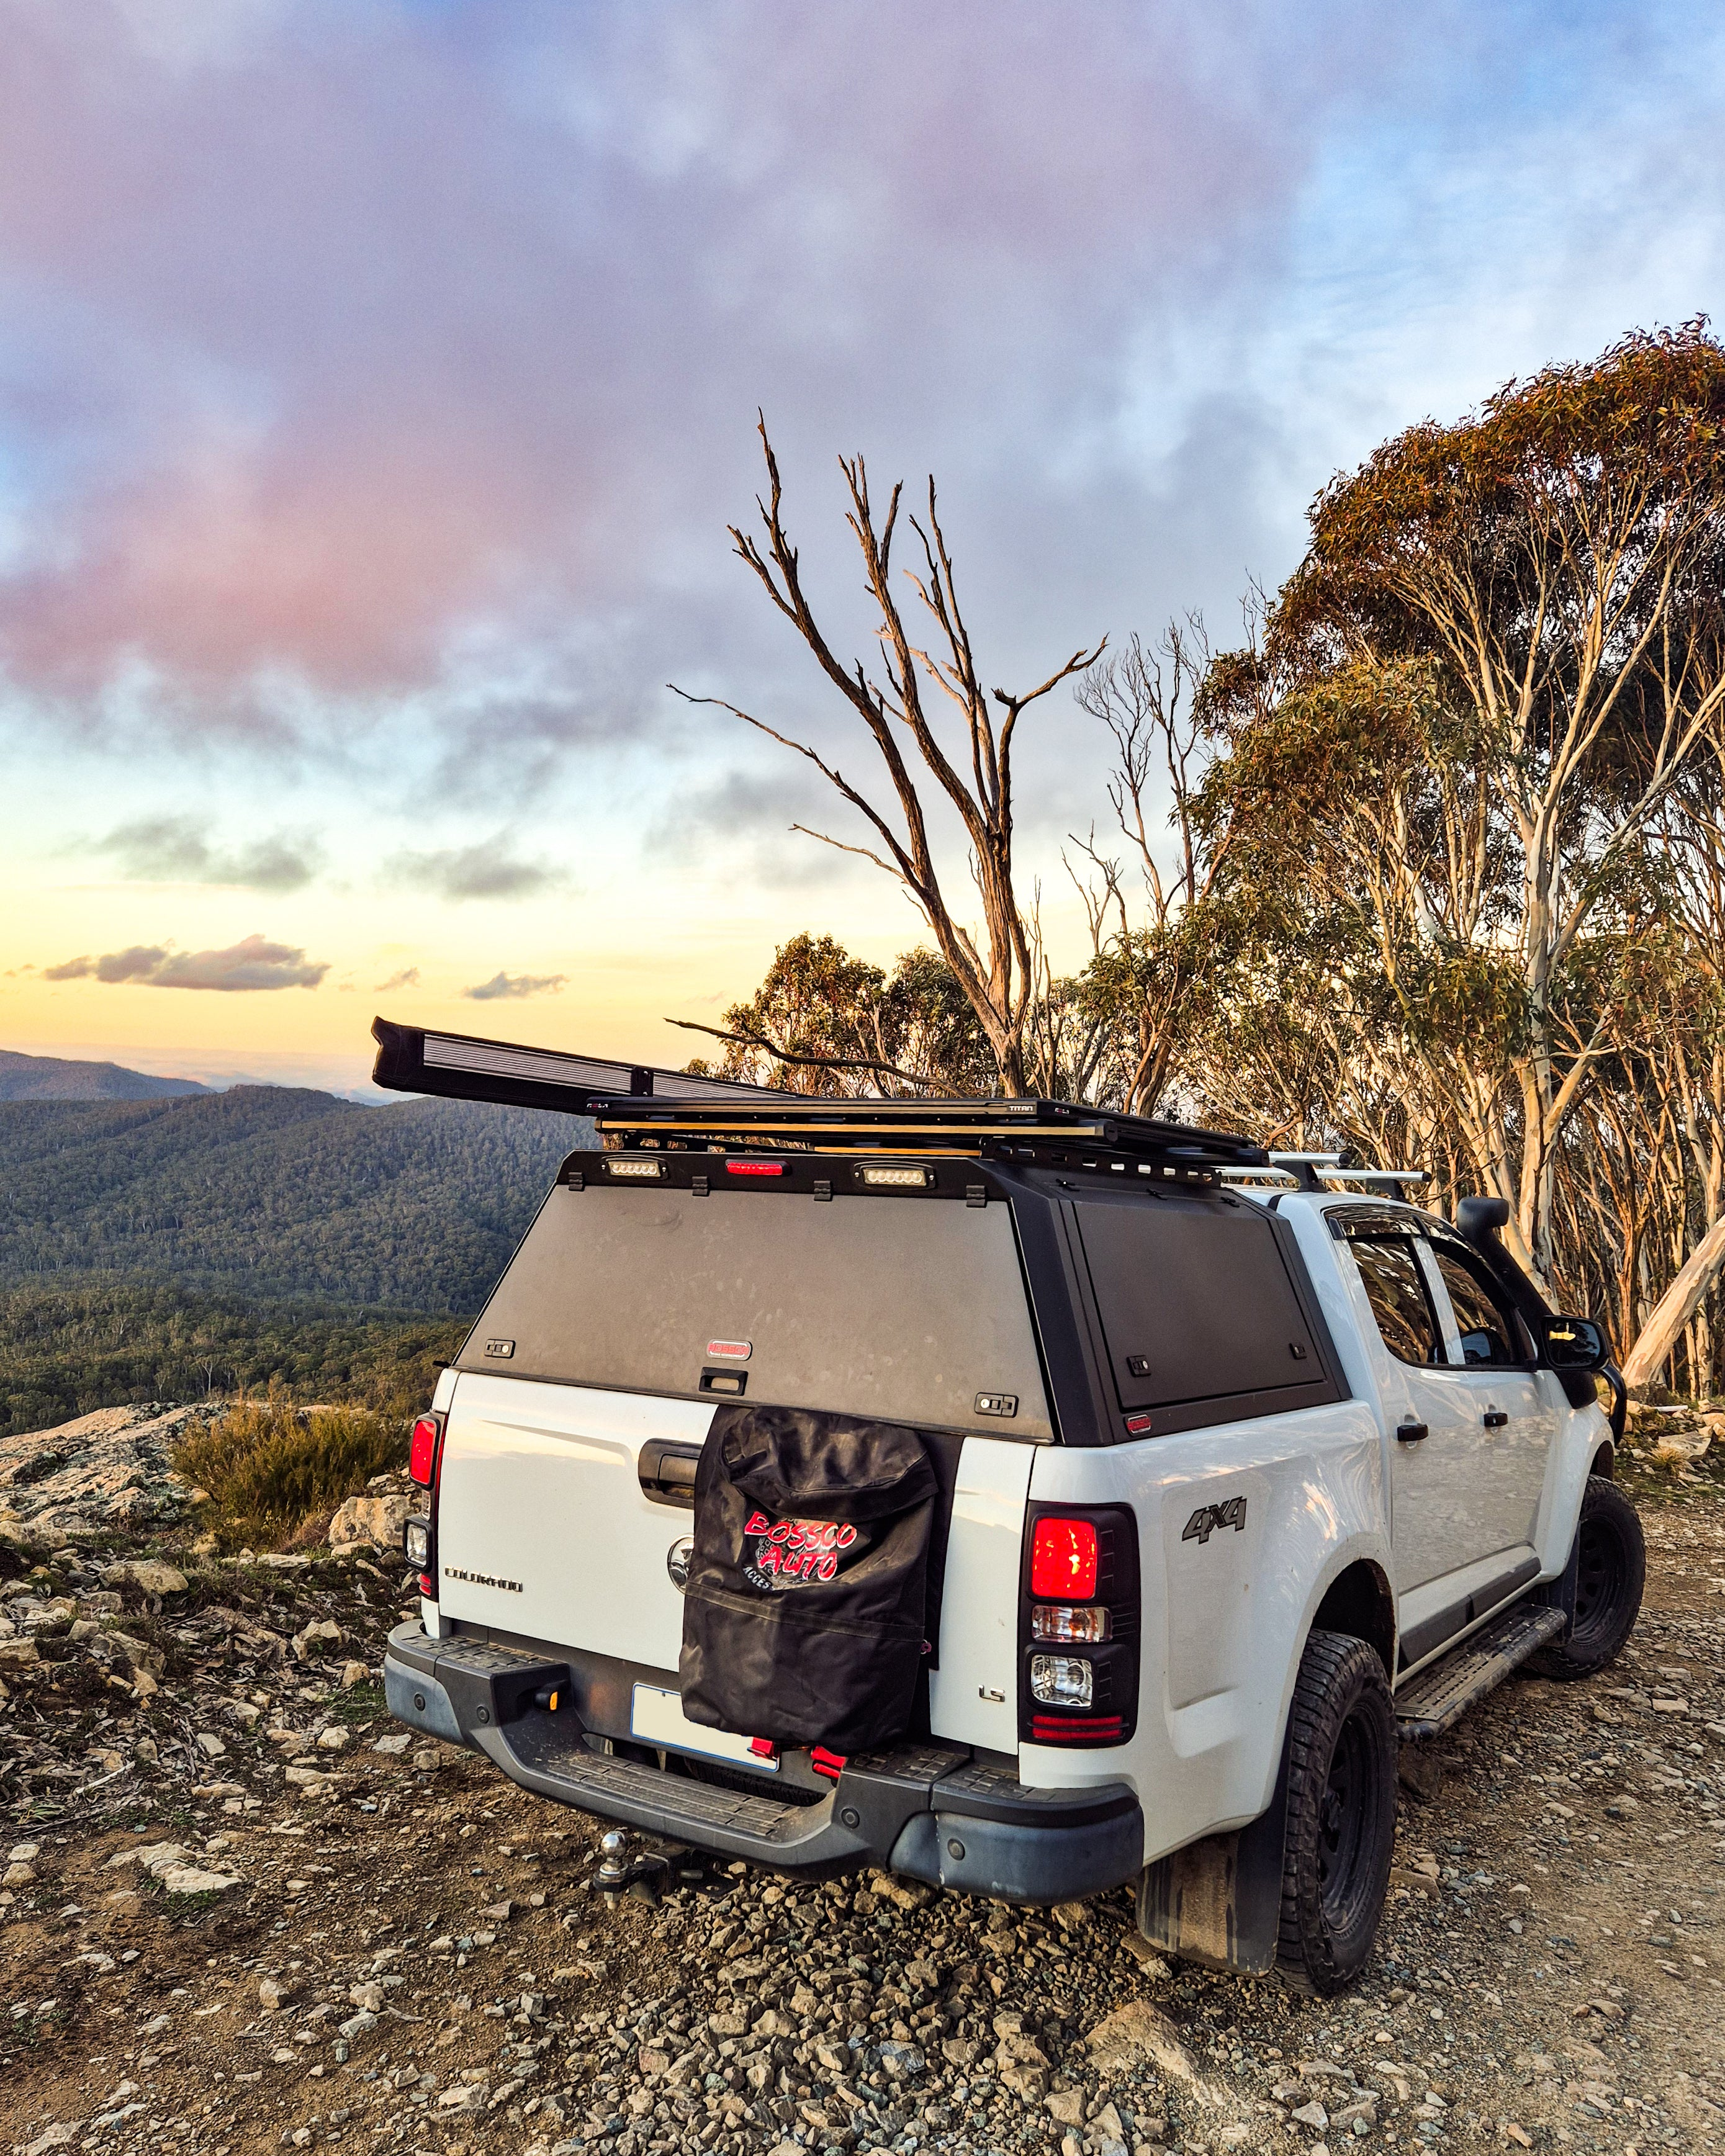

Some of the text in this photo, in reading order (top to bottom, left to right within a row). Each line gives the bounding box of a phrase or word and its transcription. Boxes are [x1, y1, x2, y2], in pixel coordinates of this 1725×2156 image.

[708, 1343, 749, 1355] BOSSCO
[744, 1511, 857, 1552] BOSSCO
[758, 1545, 837, 1581] AUTO
[444, 1566, 523, 1592] COLORADO
[978, 1684, 1005, 1702] LS
